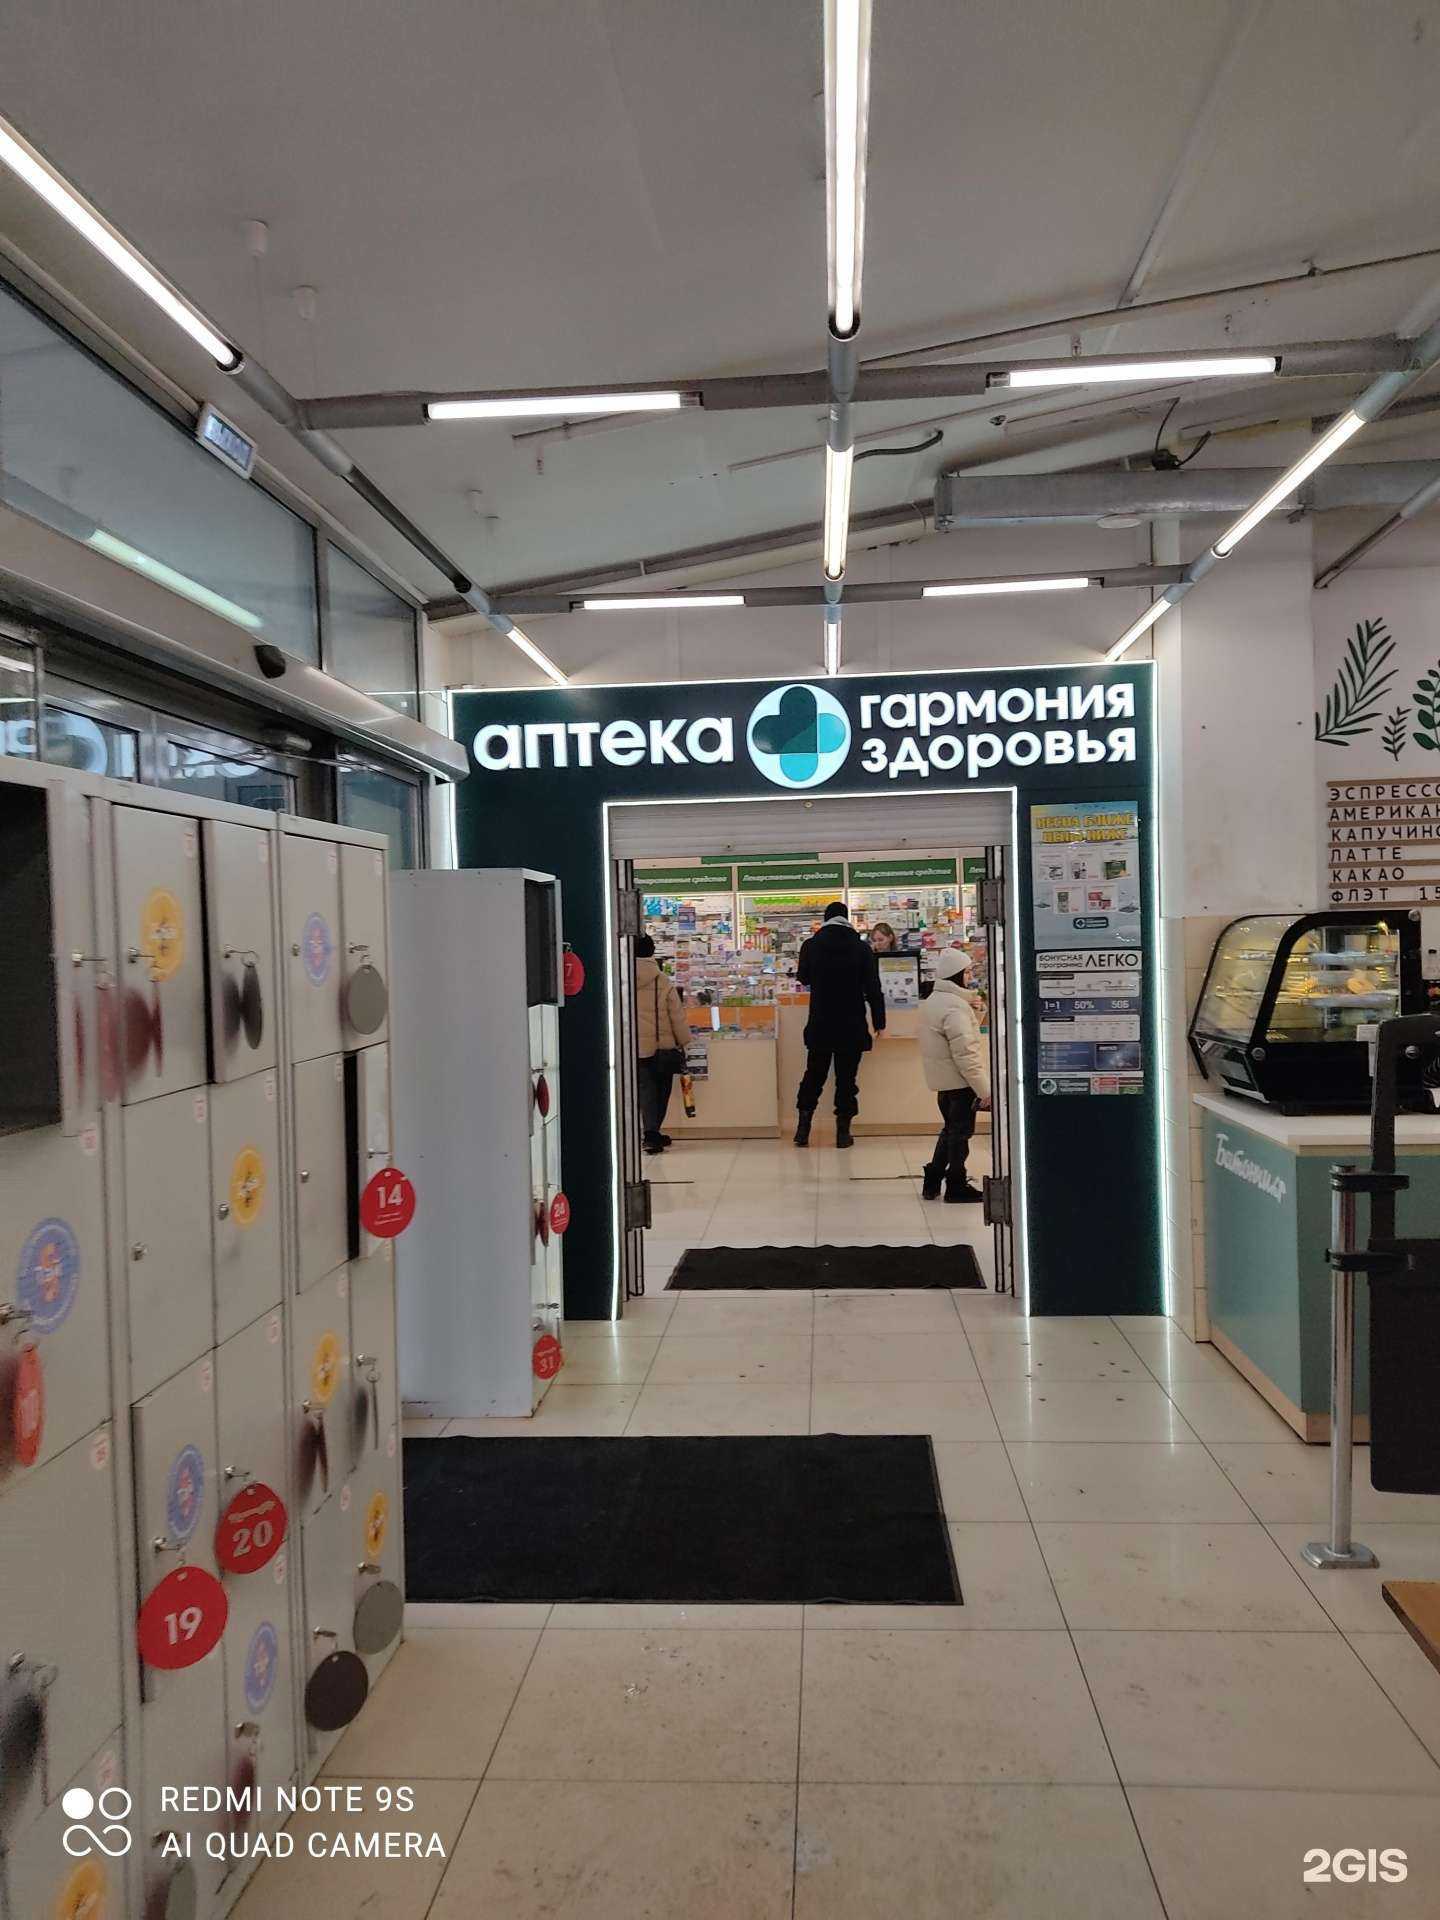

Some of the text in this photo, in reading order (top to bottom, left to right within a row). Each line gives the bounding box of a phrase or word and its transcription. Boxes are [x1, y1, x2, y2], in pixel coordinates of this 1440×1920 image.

[859, 681, 1136, 731] гармония
[472, 714, 735, 771] аптека
[860, 725, 1137, 779] здоровья
[1331, 846, 1402, 861] ЛАТТЕ
[1332, 867, 1405, 882] КАКАО
[1331, 887, 1389, 903] ФЛЭТ
[1085, 953, 1138, 967] ЛЕГКО
[376, 1183, 404, 1209] 14
[232, 1520, 273, 1558] 20
[164, 1606, 203, 1646] 19
